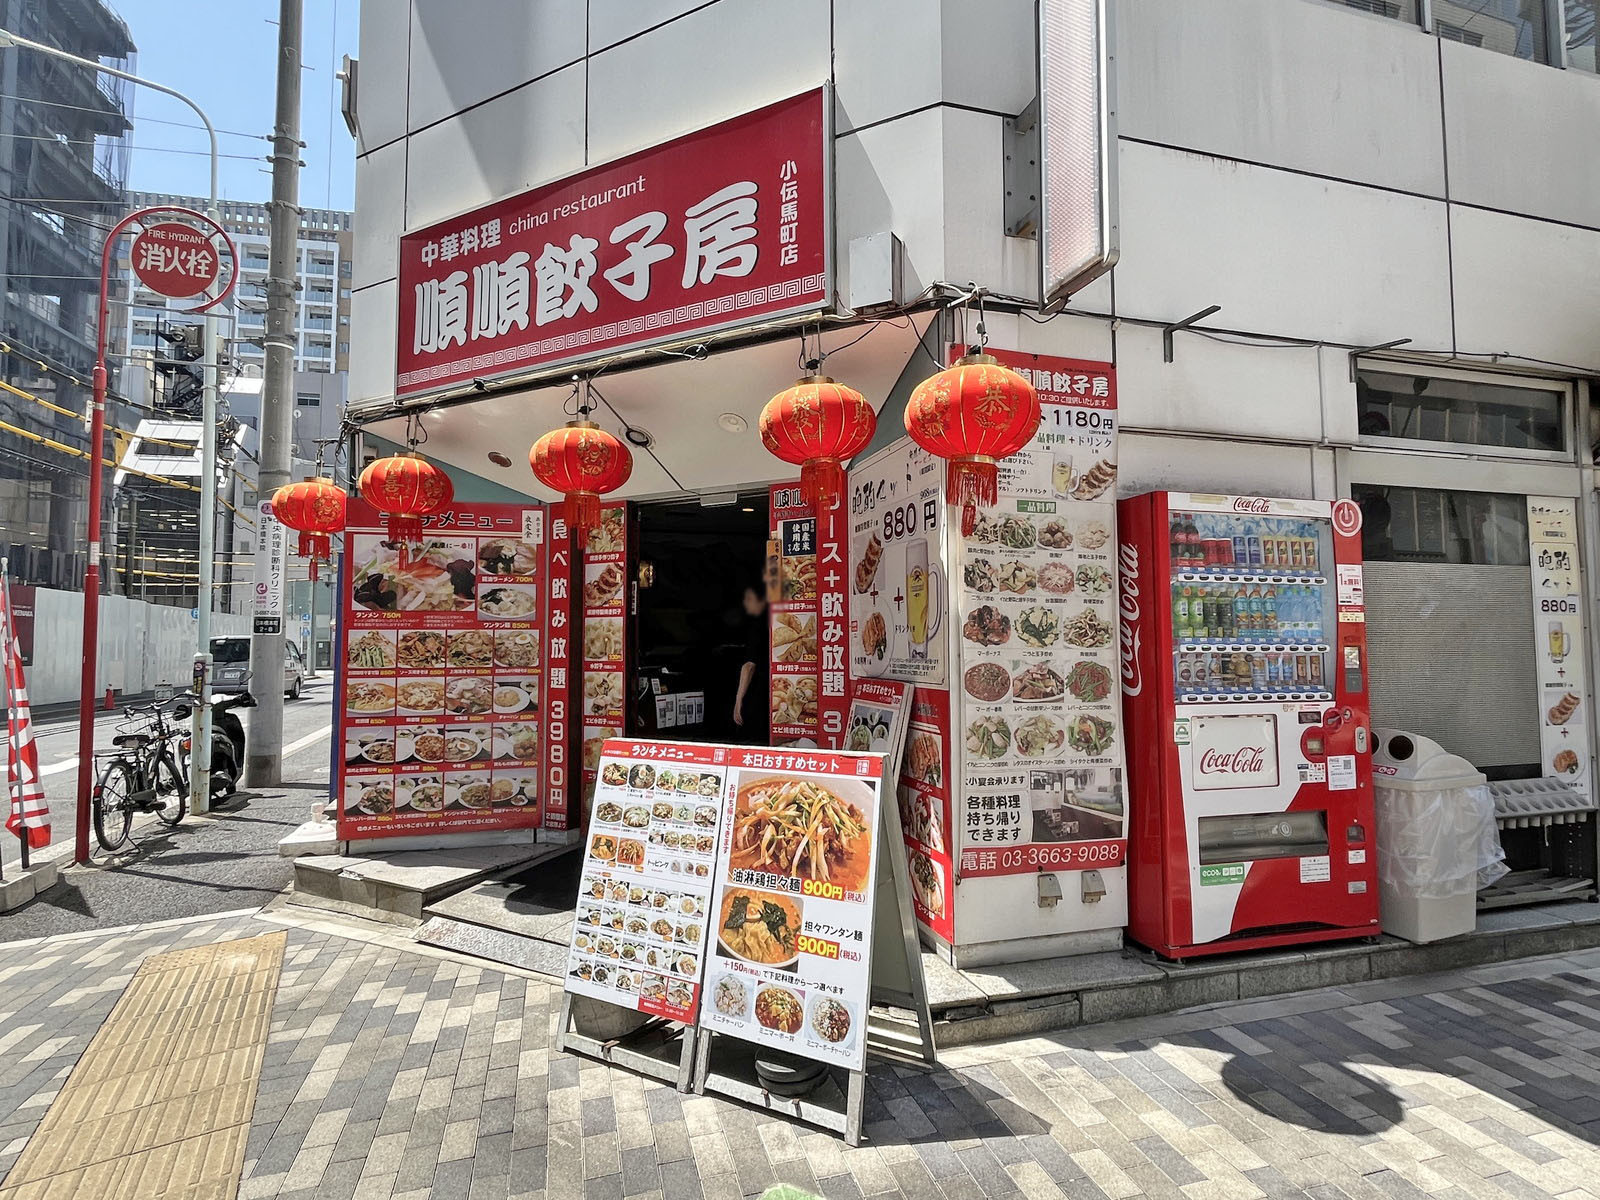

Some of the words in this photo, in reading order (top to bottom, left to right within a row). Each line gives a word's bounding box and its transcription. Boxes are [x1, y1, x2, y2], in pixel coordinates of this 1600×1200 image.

[509, 212, 549, 236] china
[552, 175, 646, 222] restaurant
[779, 159, 798, 267] 小伝馬町店
[147, 229, 166, 240] FIRE
[168, 232, 206, 245] HYDRANT
[421, 218, 501, 268] 中華料理
[139, 242, 212, 279] 消火栓
[413, 180, 759, 356] 順順餃子房
[1053, 409, 1113, 430] 1180円
[1018, 500, 1056, 512] 一品料理
[883, 499, 937, 541] 880円
[1541, 599, 1576, 613] 880円
[631, 744, 694, 759] ランチメニュー
[742, 752, 840, 773] 本日おすすめセット
[1200, 746, 1267, 775] Coca-Cola
[965, 775, 1026, 788] 小宴会承ります
[967, 795, 1021, 810] 各種料理
[966, 811, 1022, 827] 持ち帰り
[967, 827, 1022, 842] できます
[961, 851, 997, 871] 電話
[1002, 844, 1120, 868] 03-3663-9088
[733, 868, 801, 893] 油淋鶏担々麺
[803, 878, 843, 901] 900円
[843, 890, 866, 904] (税込)
[804, 920, 864, 942] 担々ワンタン麺
[797, 937, 838, 959] 900円
[839, 948, 862, 963] (税込)
